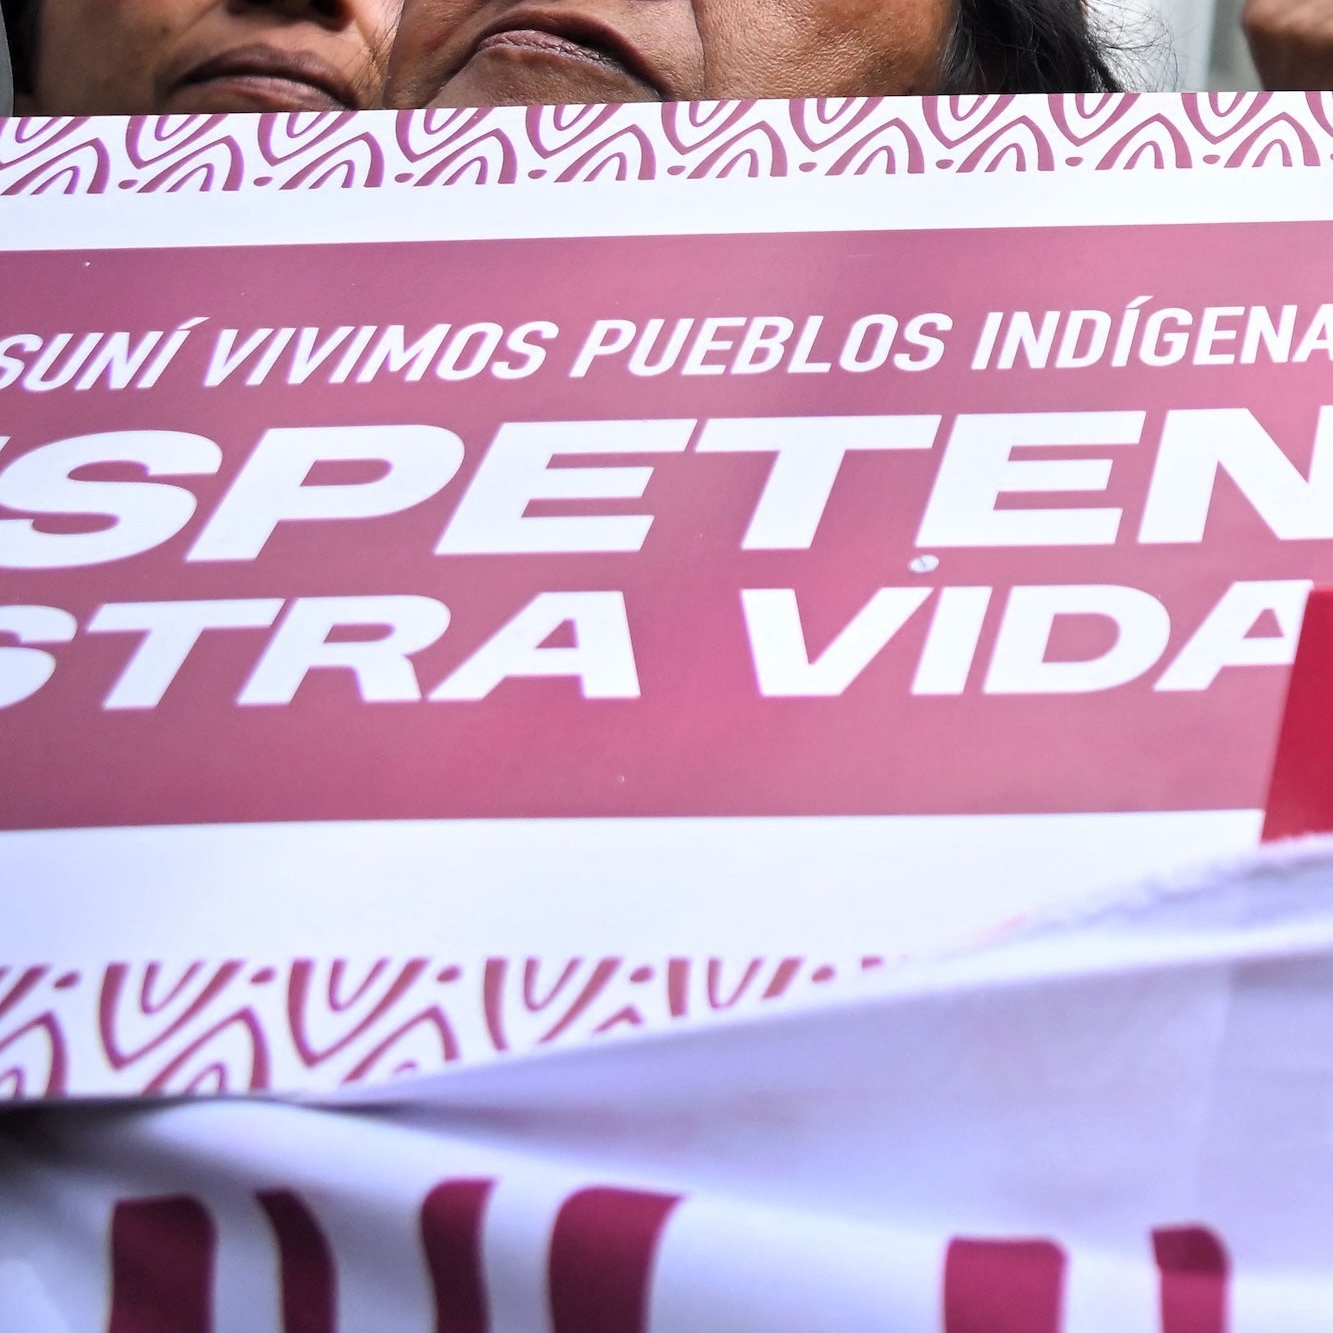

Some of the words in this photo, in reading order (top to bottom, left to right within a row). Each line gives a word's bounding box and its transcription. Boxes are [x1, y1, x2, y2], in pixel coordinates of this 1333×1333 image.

[204, 320, 559, 387] VIVIMOS
[569, 312, 953, 378] PUEBLOS
[740, 579, 1314, 697] VIDA
